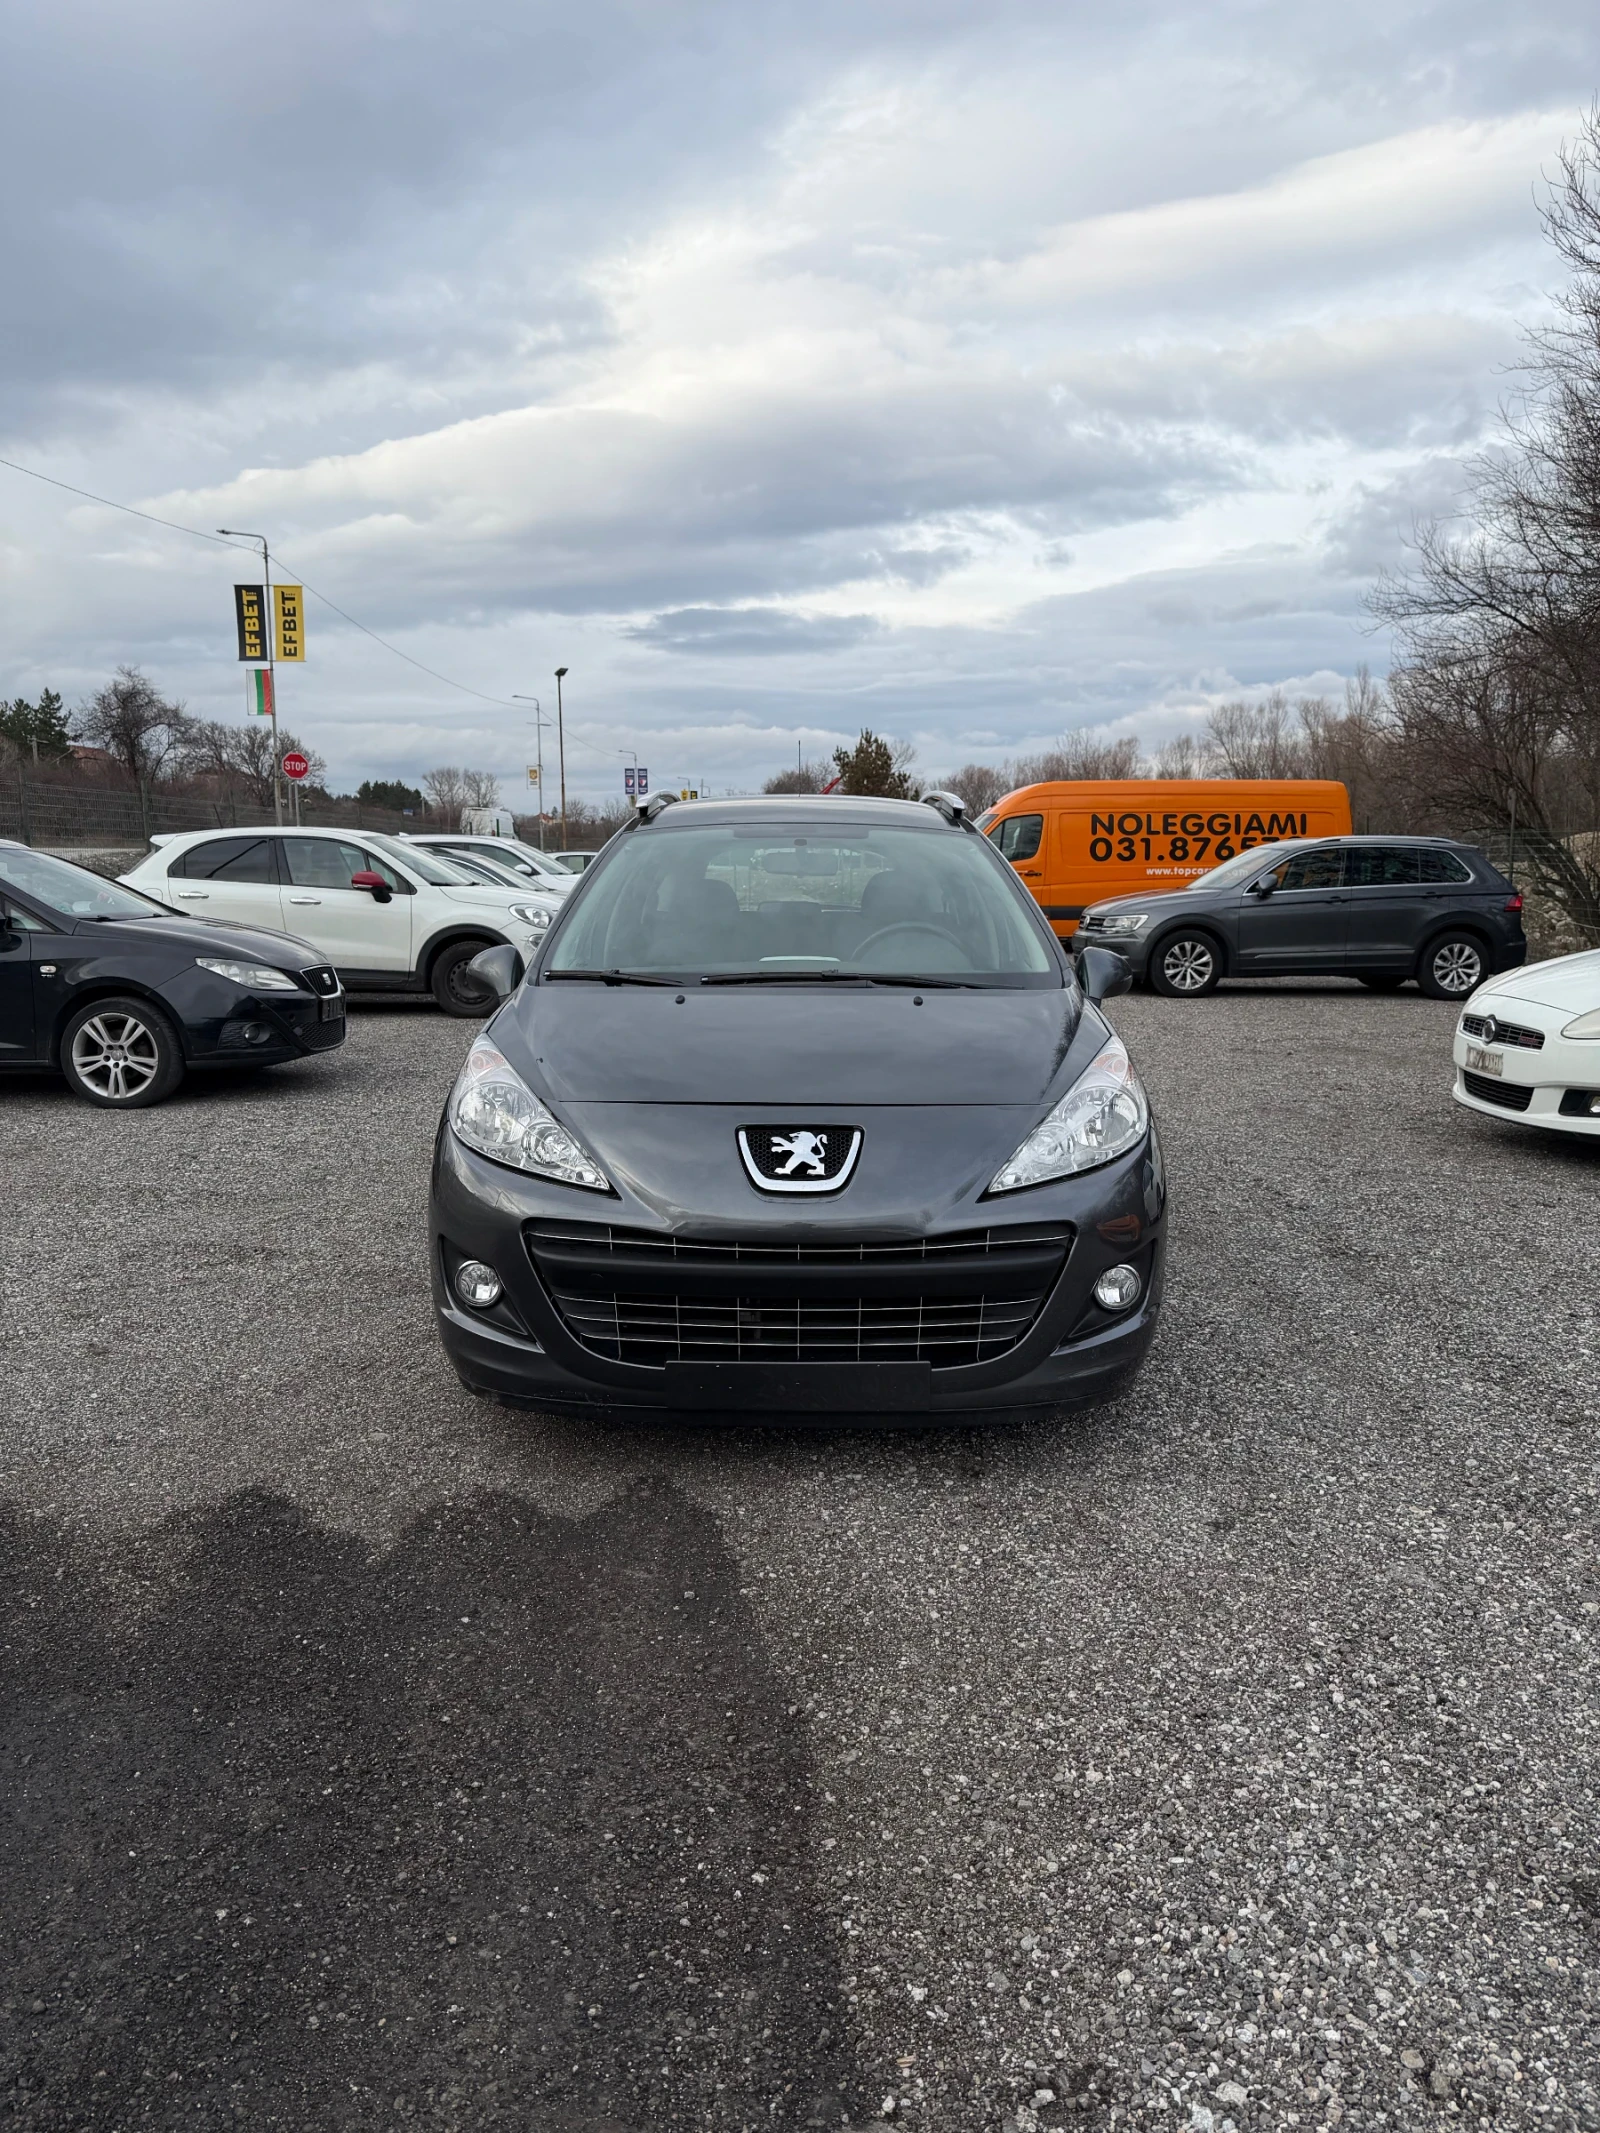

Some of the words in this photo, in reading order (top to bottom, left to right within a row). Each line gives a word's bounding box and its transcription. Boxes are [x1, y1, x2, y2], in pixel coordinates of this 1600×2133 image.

[242, 589, 261, 657] EFBET
[281, 590, 298, 657] EFBET
[285, 761, 306, 771] STOP
[1091, 813, 1307, 836] NOLEGGIAMI
[1089, 836, 1303, 862] 031.8765
